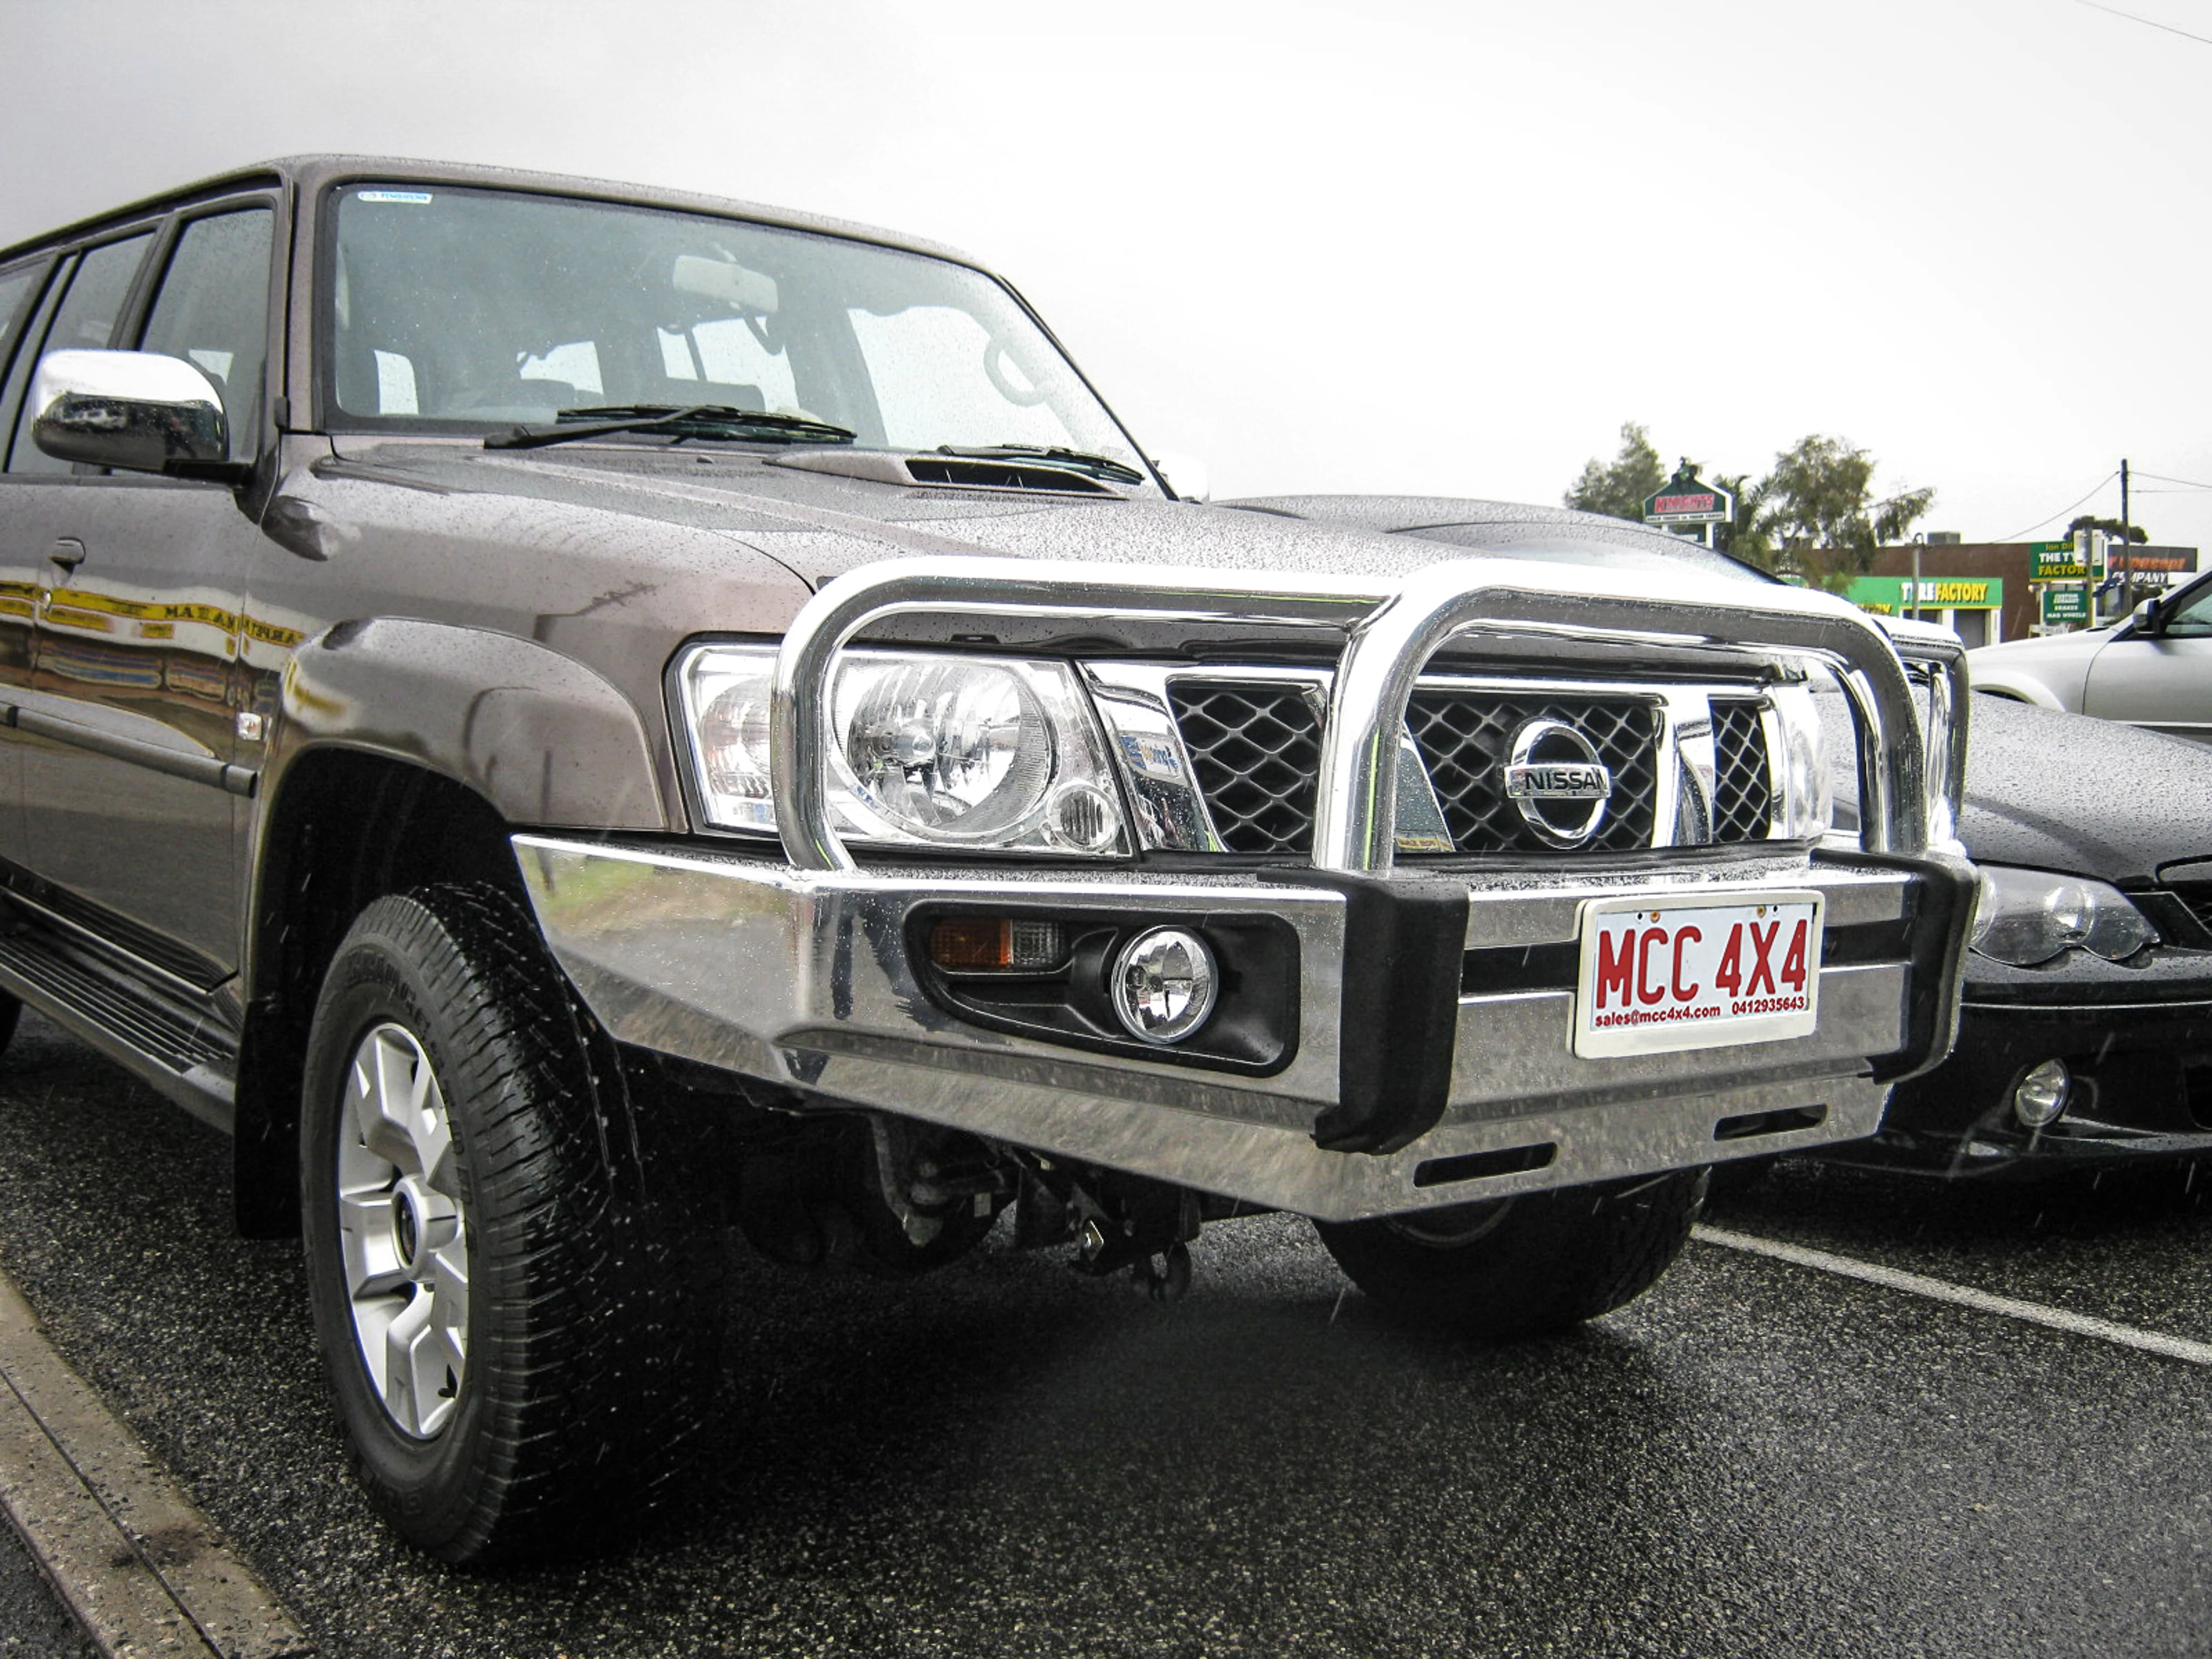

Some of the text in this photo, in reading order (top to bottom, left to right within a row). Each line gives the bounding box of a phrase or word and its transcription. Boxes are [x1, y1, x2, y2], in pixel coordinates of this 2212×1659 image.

[2039, 552, 2061, 563] THE
[2038, 565, 2087, 576] FACTOR
[1936, 582, 1987, 602] FACTORY
[1525, 772, 1608, 790] NISSAN
[1596, 919, 1808, 1009] MCC 4X4
[1595, 995, 1804, 1026] sales@mcc4x4.com 0412935643
